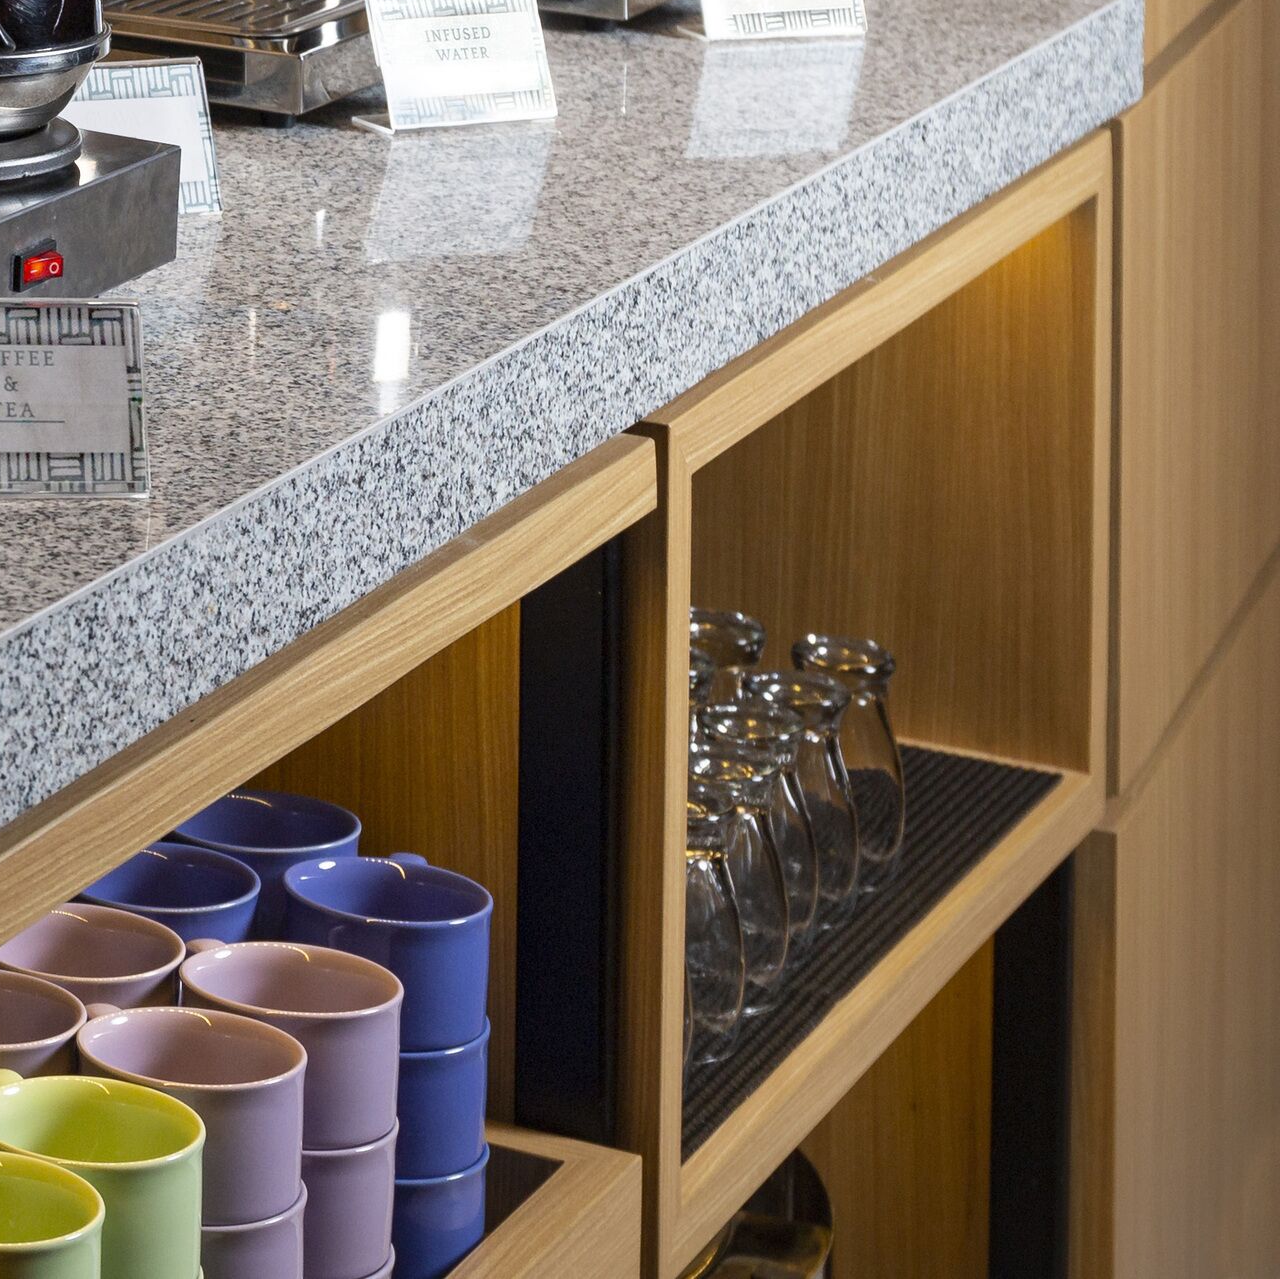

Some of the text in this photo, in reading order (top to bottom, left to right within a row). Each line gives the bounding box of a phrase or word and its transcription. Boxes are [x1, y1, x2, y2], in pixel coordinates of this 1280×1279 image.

[424, 26, 491, 43] INFUSED
[435, 46, 490, 61] WATER
[3, 376, 19, 392] &
